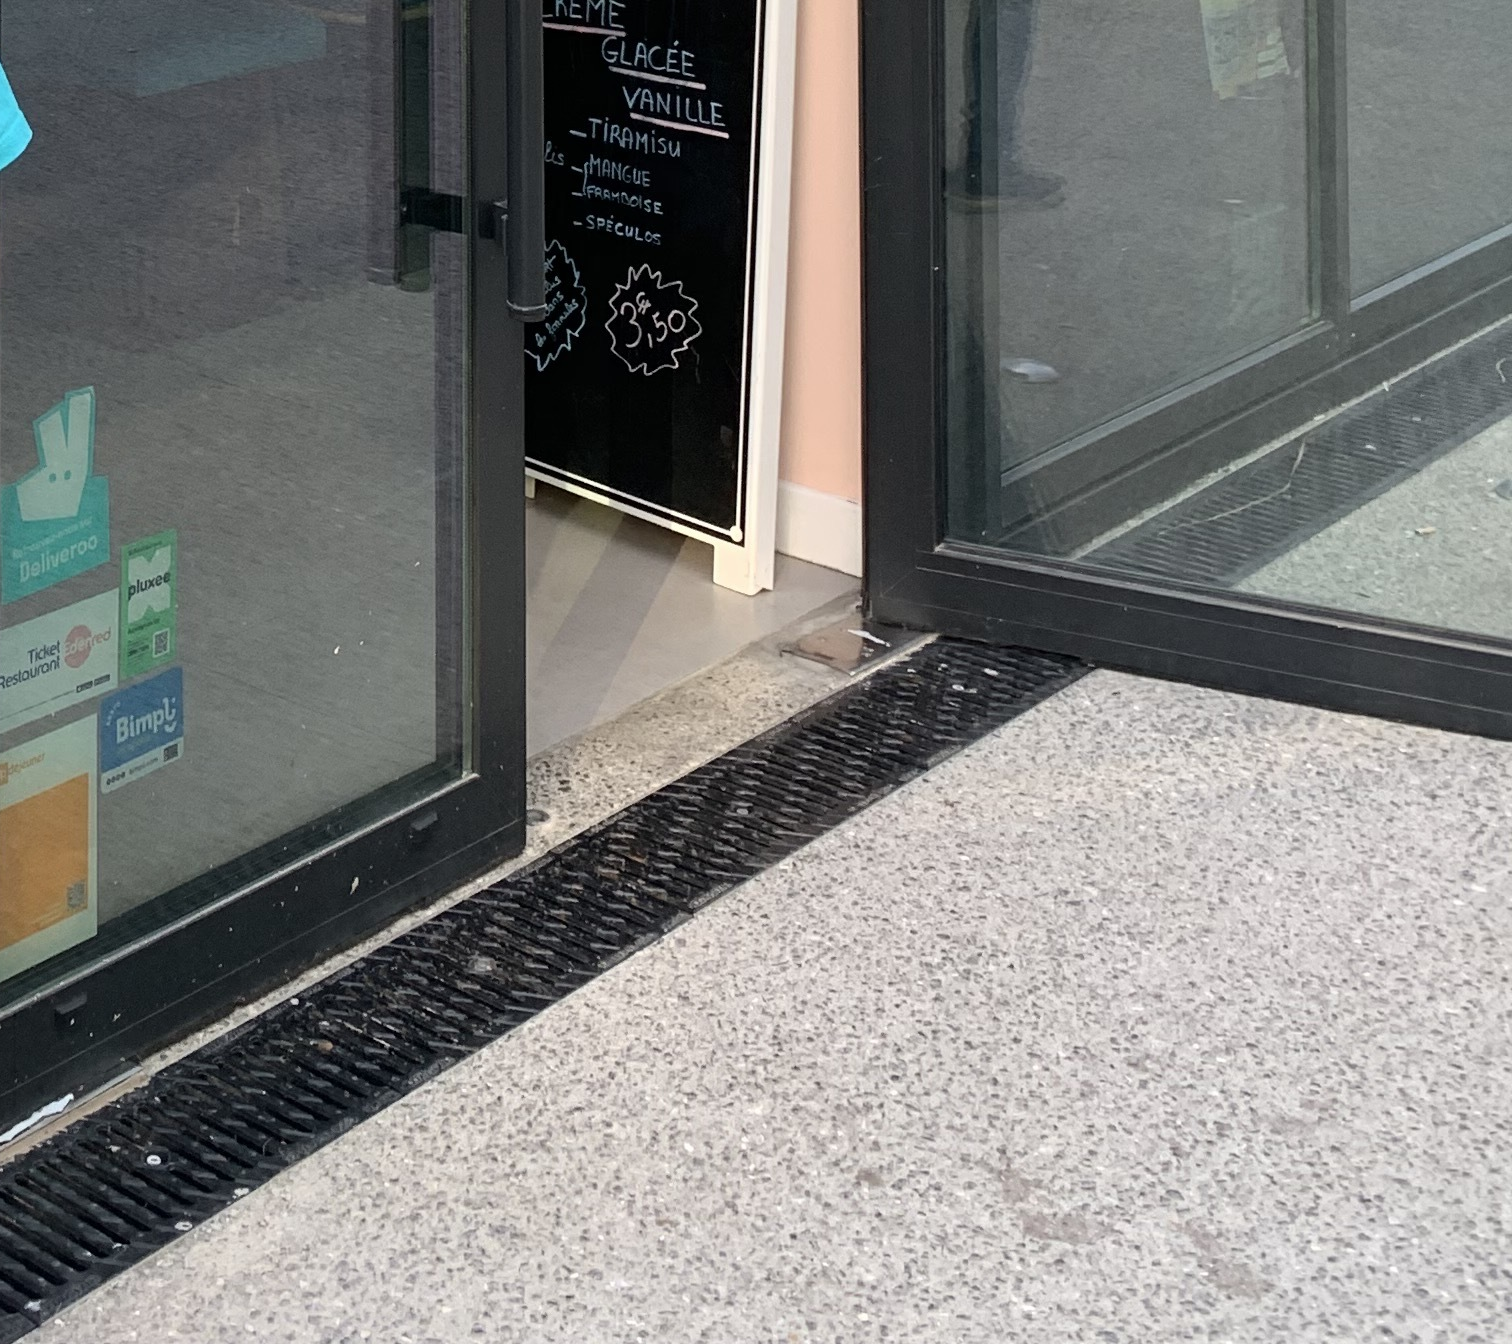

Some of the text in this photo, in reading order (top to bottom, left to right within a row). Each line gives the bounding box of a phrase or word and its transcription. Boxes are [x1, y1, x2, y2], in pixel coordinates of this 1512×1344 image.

[601, 35, 696, 77] GLACÉE
[622, 86, 726, 127] VANILLE
[589, 153, 651, 188] MANGUE
[20, 534, 98, 584] Deliveroo
[127, 570, 172, 603] pluxee
[27, 639, 61, 665] Ticket
[64, 626, 112, 655] Edenred
